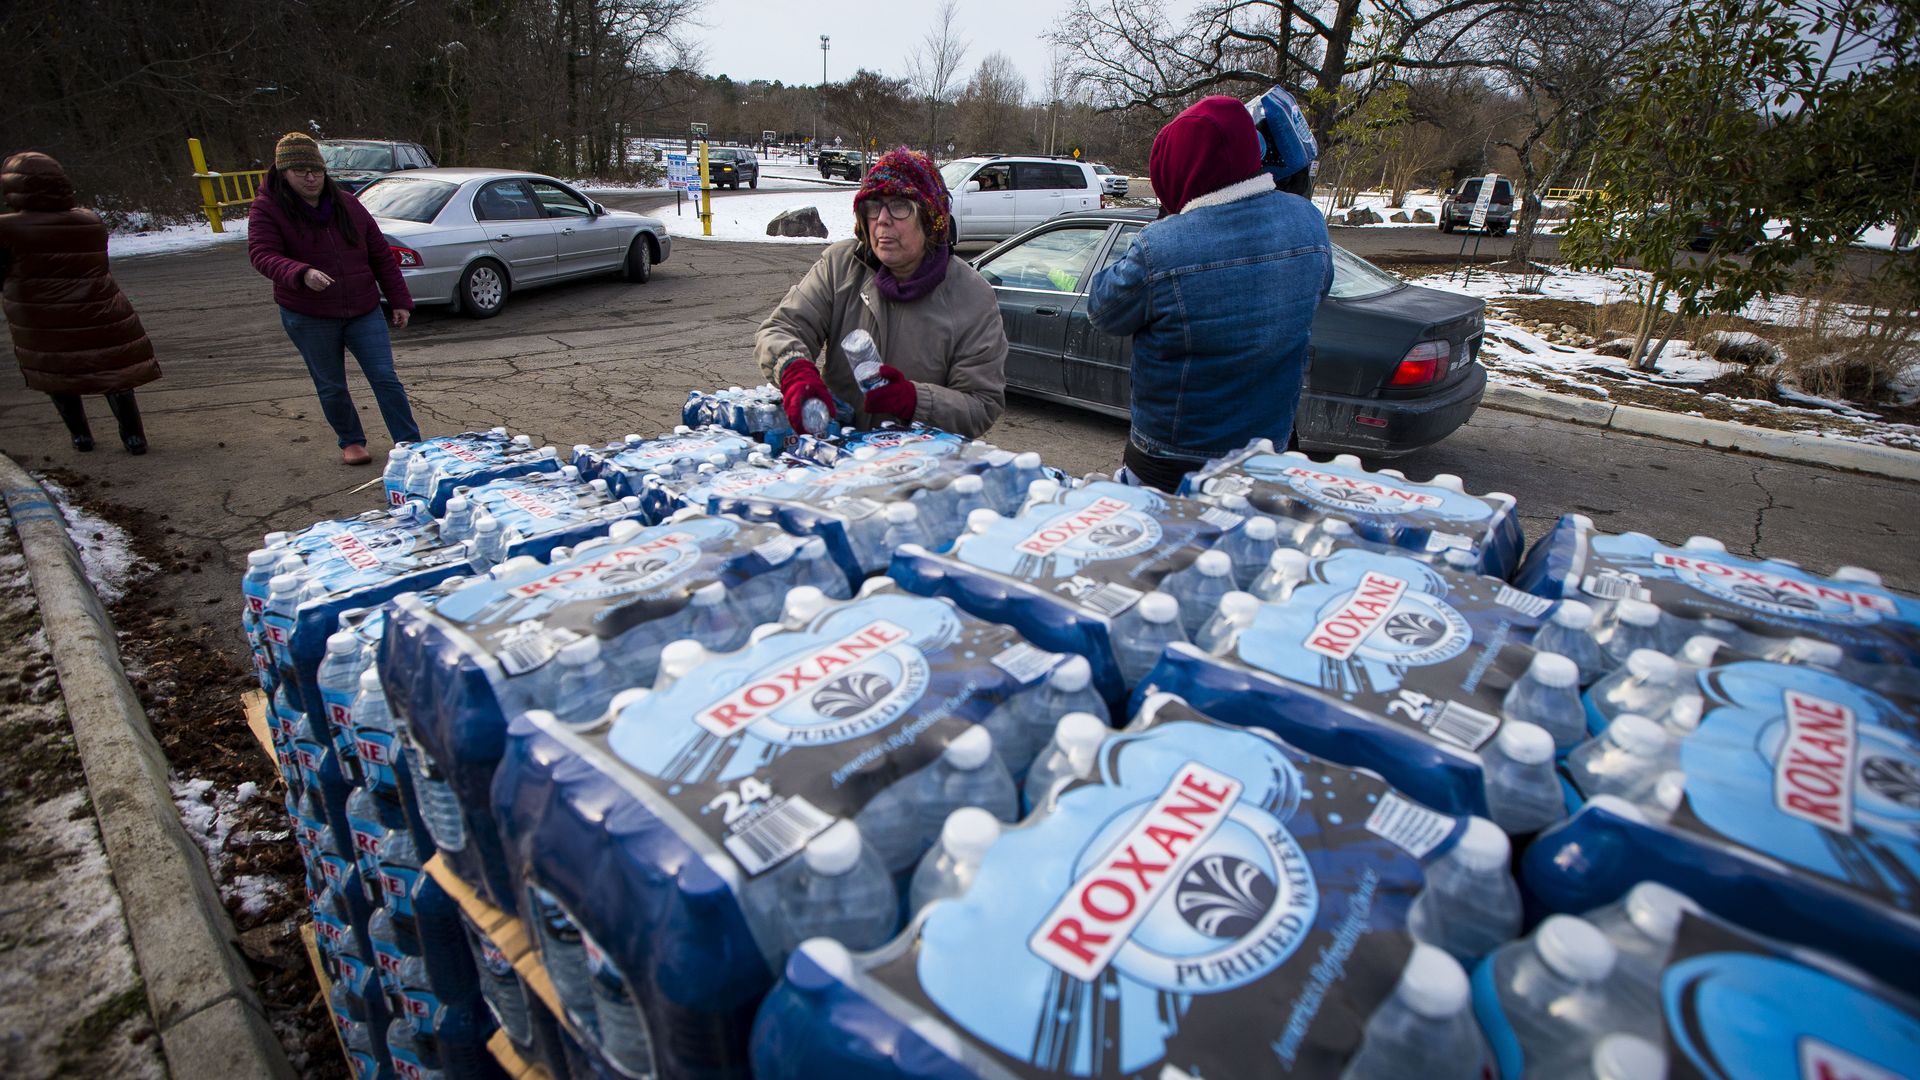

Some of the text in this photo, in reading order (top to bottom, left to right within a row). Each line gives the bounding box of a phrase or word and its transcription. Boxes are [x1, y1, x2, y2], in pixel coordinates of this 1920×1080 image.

[1292, 468, 1433, 505] ROXANE
[1024, 499, 1126, 552] ROXANE
[519, 536, 681, 594] ROXANE
[1664, 556, 1885, 610] ROXANE
[1313, 575, 1401, 655] ROXANE
[709, 626, 900, 730] ROXANE
[1390, 688, 1433, 722] 24
[786, 704, 899, 741] PURIFIED
[1786, 697, 1846, 824] ROXANE
[709, 776, 771, 824] 24
[1046, 772, 1234, 967] ROXANE
[1175, 829, 1310, 986] PURIFIED WATER
